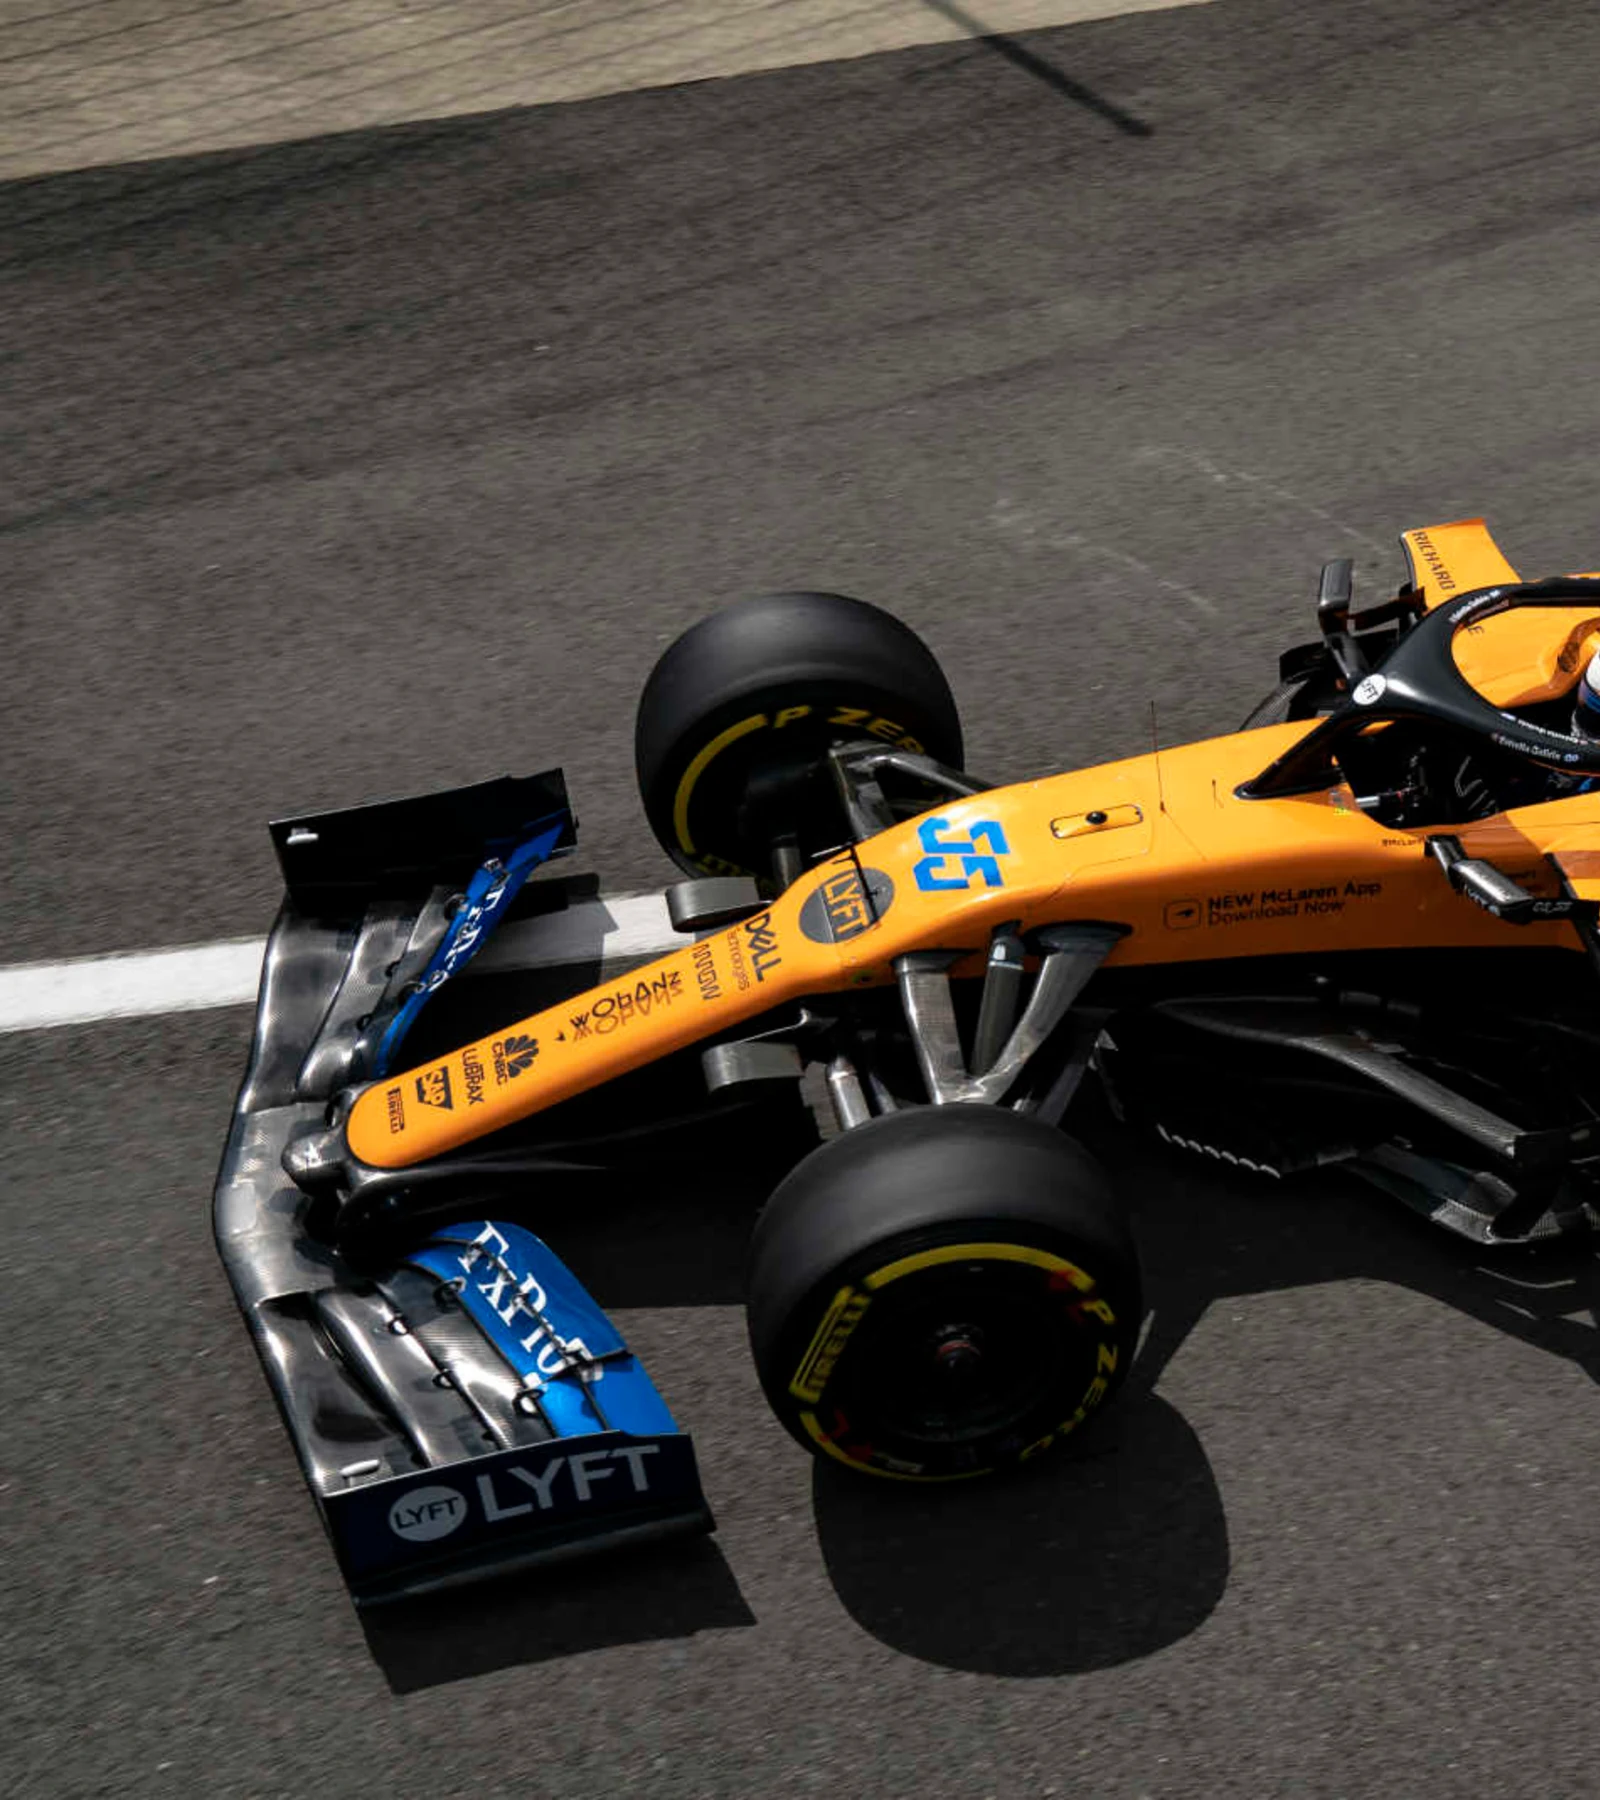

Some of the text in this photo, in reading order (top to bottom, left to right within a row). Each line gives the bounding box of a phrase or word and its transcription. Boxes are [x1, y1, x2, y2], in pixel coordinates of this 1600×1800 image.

[1413, 531, 1456, 590] RICHARD
[913, 817, 1011, 892] 55
[823, 872, 871, 934] LYFT
[1208, 879, 1383, 910] NEW McLaren App
[1304, 901, 1346, 916] Now
[744, 912, 782, 982] DELL
[421, 1069, 448, 1107] SAP
[462, 1048, 485, 1105] LUBRAX
[475, 1444, 661, 1522] LYFT
[394, 1496, 460, 1529] LYFT
